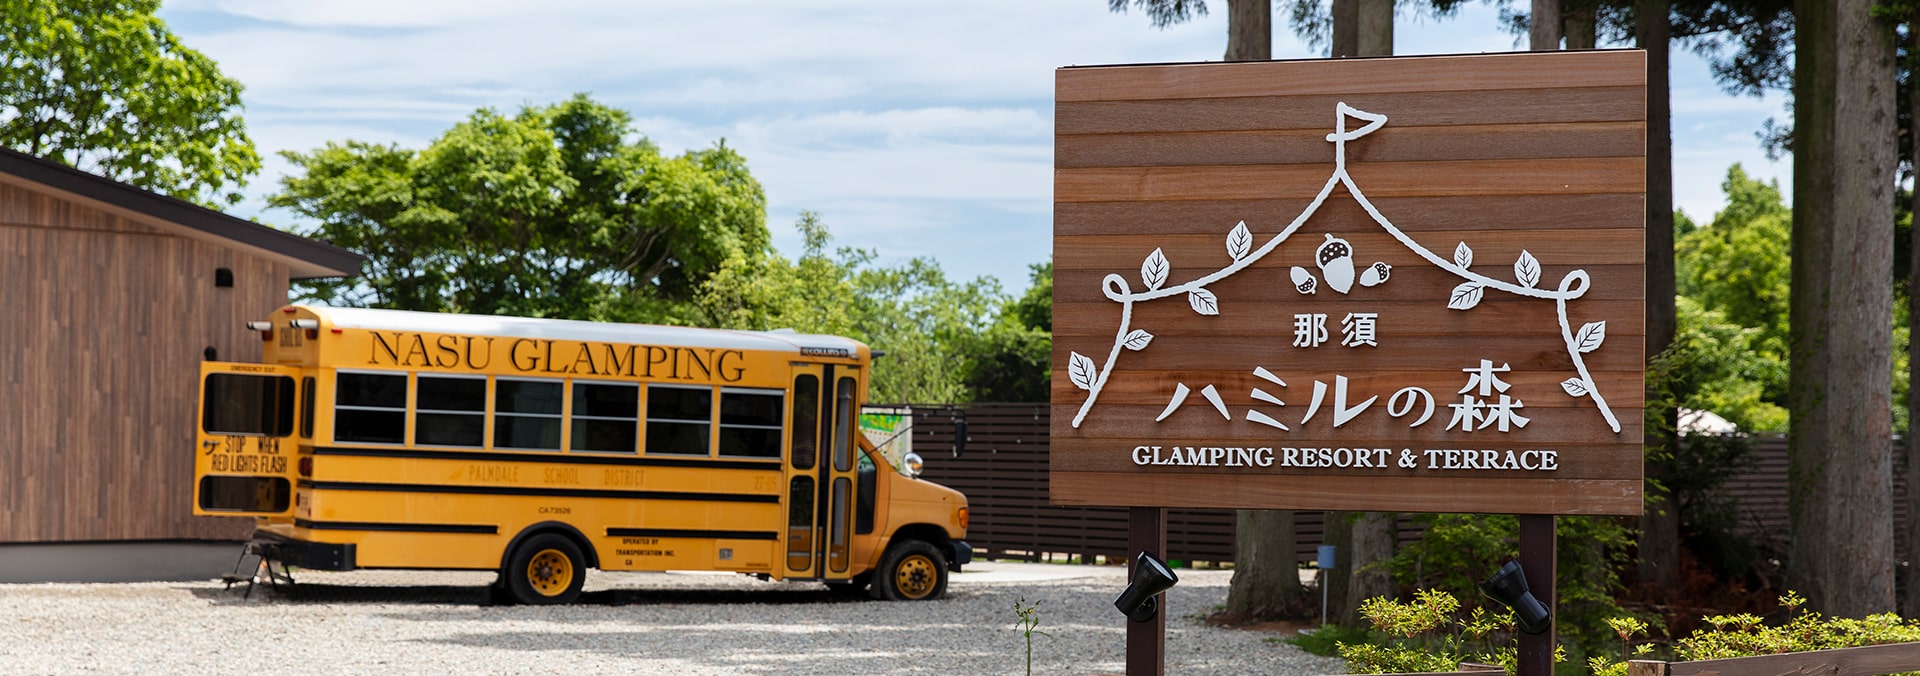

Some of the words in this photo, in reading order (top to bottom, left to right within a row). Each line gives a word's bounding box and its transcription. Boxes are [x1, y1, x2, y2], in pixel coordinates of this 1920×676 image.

[1292, 312, 1378, 348] 那須
[367, 331, 495, 370] NASU
[508, 338, 747, 383] GLAMPING
[1156, 358, 1531, 433] ハミルの森
[225, 435, 246, 453] STOP
[257, 436, 279, 455] WHEN
[1132, 445, 1275, 468] GLAMPING
[1281, 447, 1392, 468] RESORT
[1397, 448, 1418, 469] &
[1423, 449, 1558, 471] TERRACE
[211, 454, 229, 472] RED
[230, 455, 258, 473] LIGHTS
[261, 456, 287, 473] FLASH
[468, 464, 519, 483] PALMDALE
[543, 466, 581, 485] SCHOOL
[603, 468, 646, 487] DISTRICT
